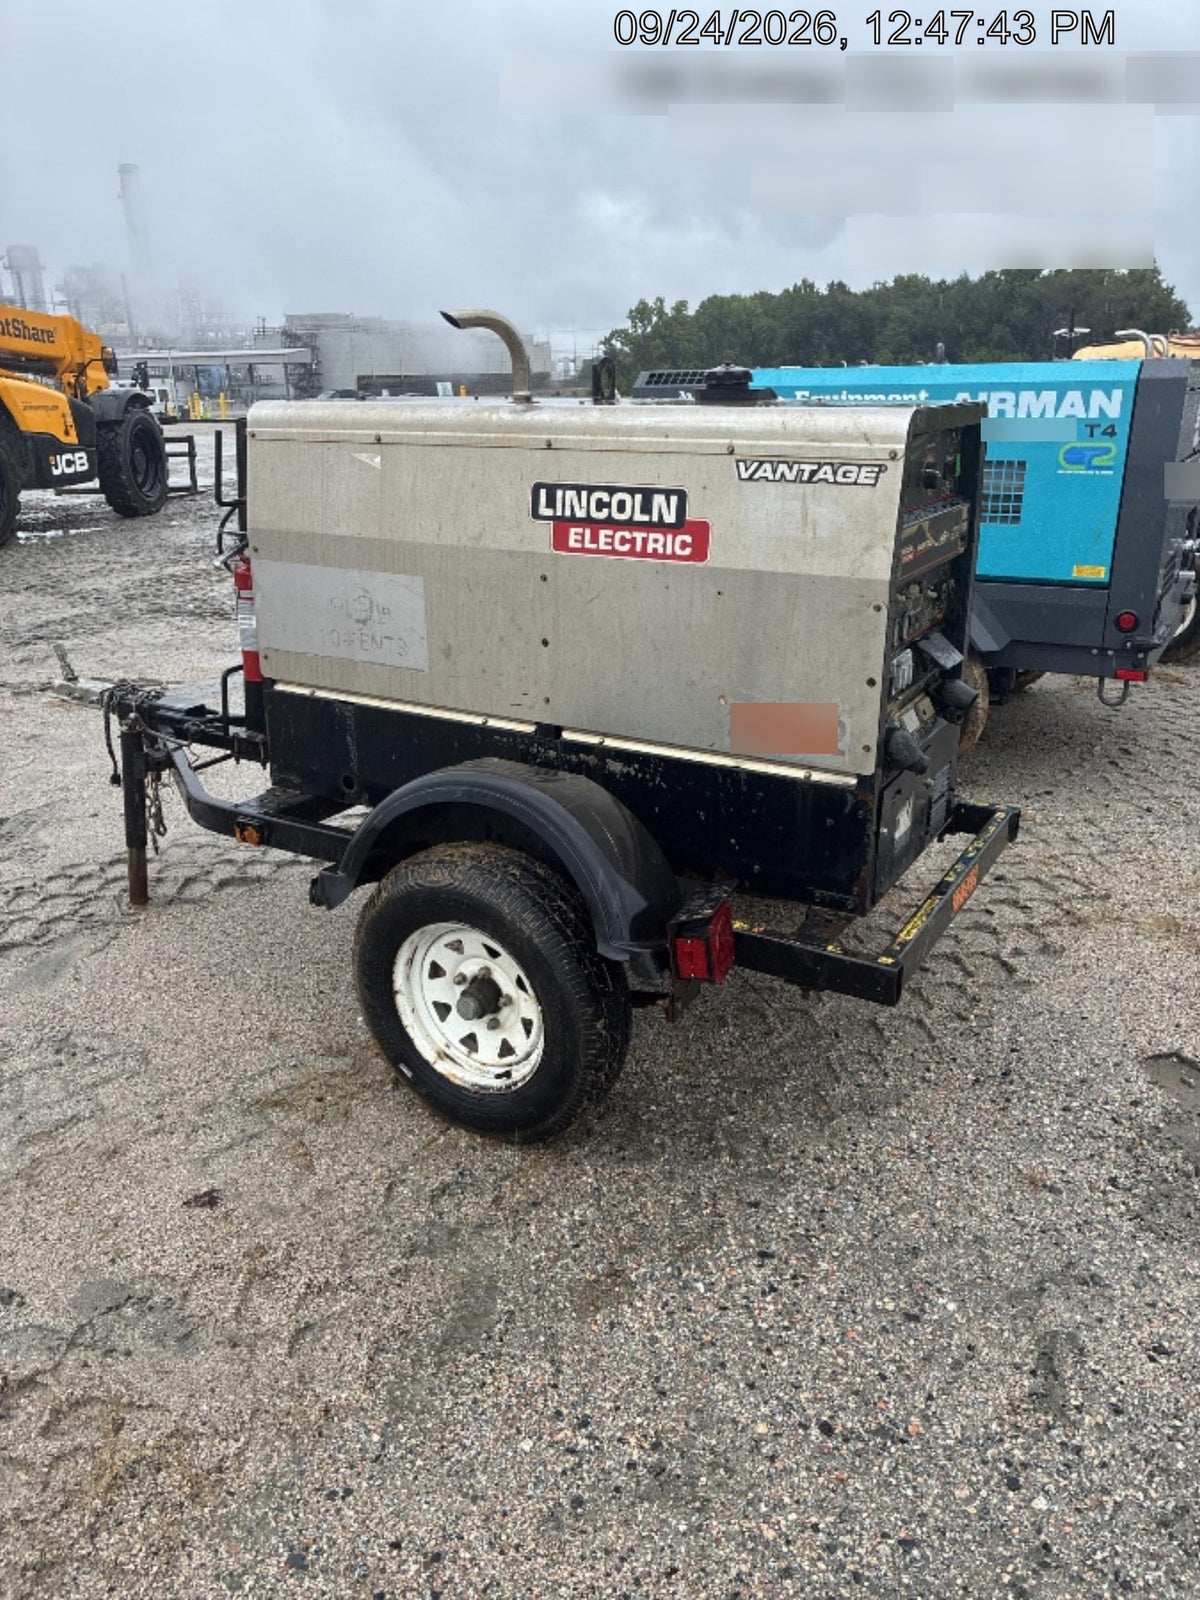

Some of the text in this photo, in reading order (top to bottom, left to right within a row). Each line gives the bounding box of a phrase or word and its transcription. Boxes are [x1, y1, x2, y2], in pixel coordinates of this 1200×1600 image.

[1085, 423, 1118, 438] T4
[51, 451, 90, 476] JCB
[737, 461, 880, 485] VANTAGE
[538, 488, 678, 524] LINCOLN
[568, 527, 693, 556] ELECTRIC
